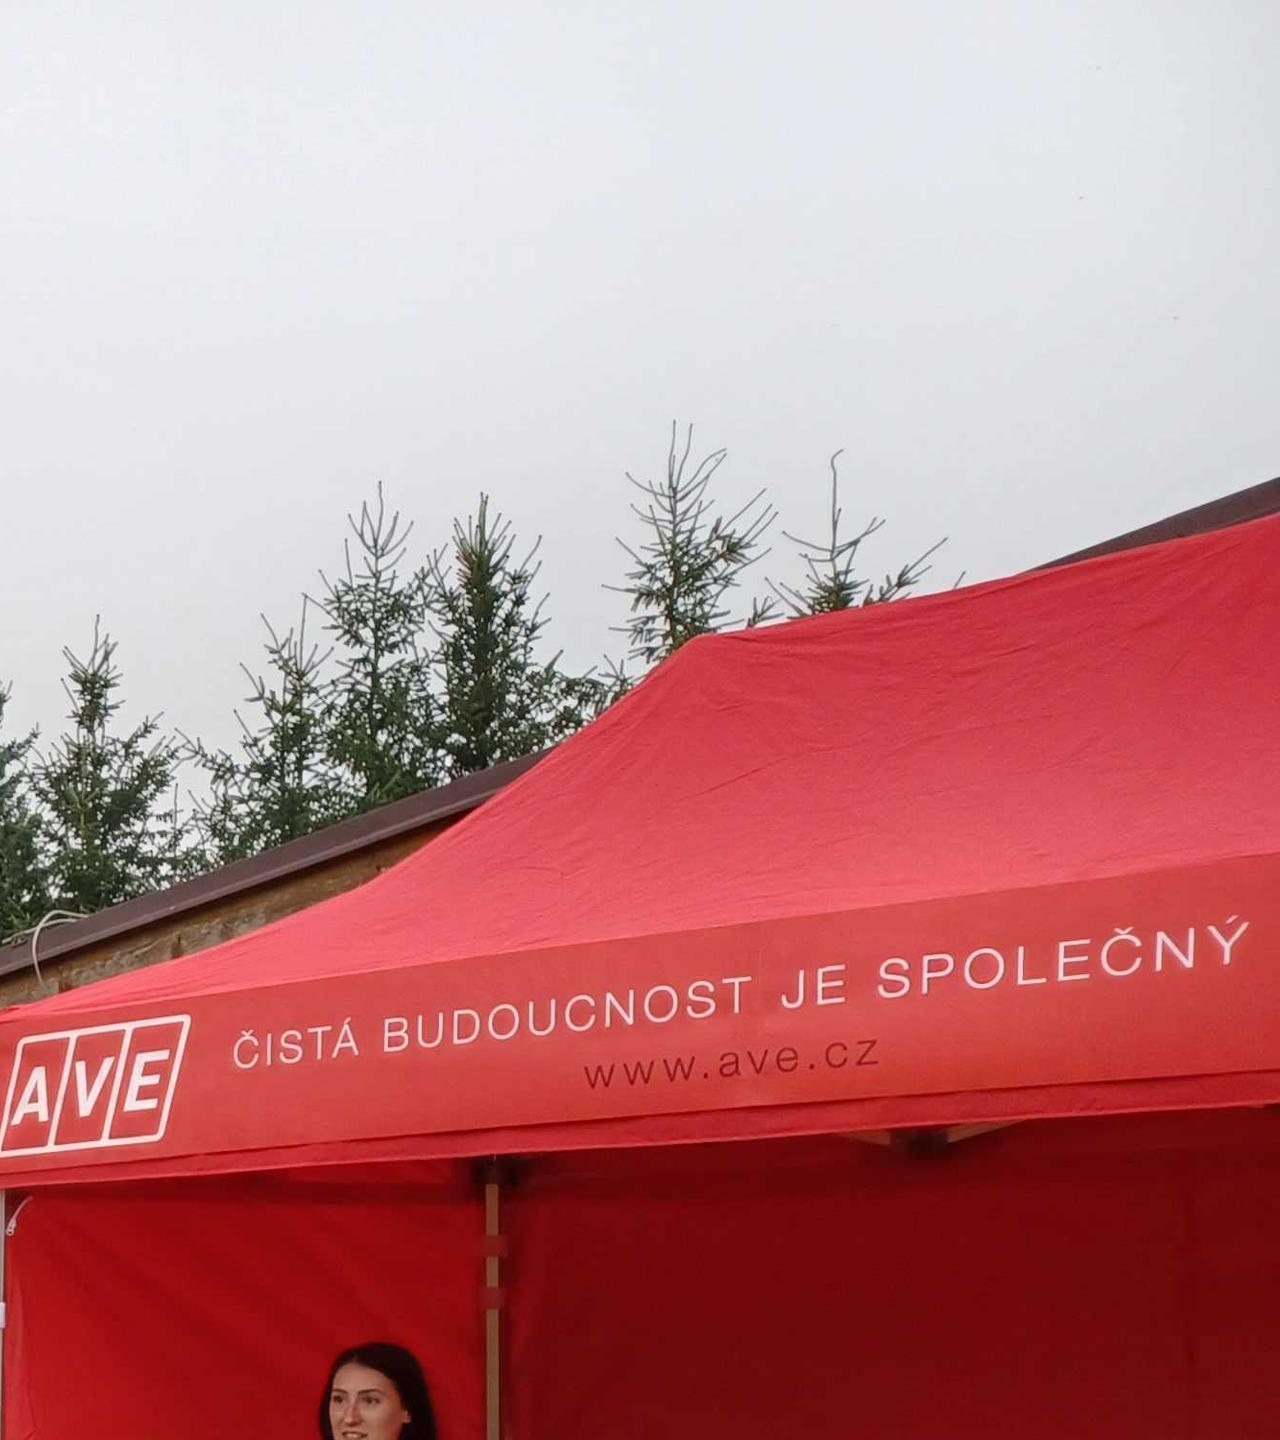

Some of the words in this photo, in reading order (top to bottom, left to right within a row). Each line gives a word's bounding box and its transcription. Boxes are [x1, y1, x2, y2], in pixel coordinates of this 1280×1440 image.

[232, 1017, 360, 1069] ČISTÁ
[383, 976, 752, 1053] BUDOUCNOST
[781, 964, 846, 1009] JE
[877, 915, 1250, 999] SPOLEČNÝ
[10, 1049, 171, 1127] AVE
[584, 1038, 880, 1089] www.ave.cz
